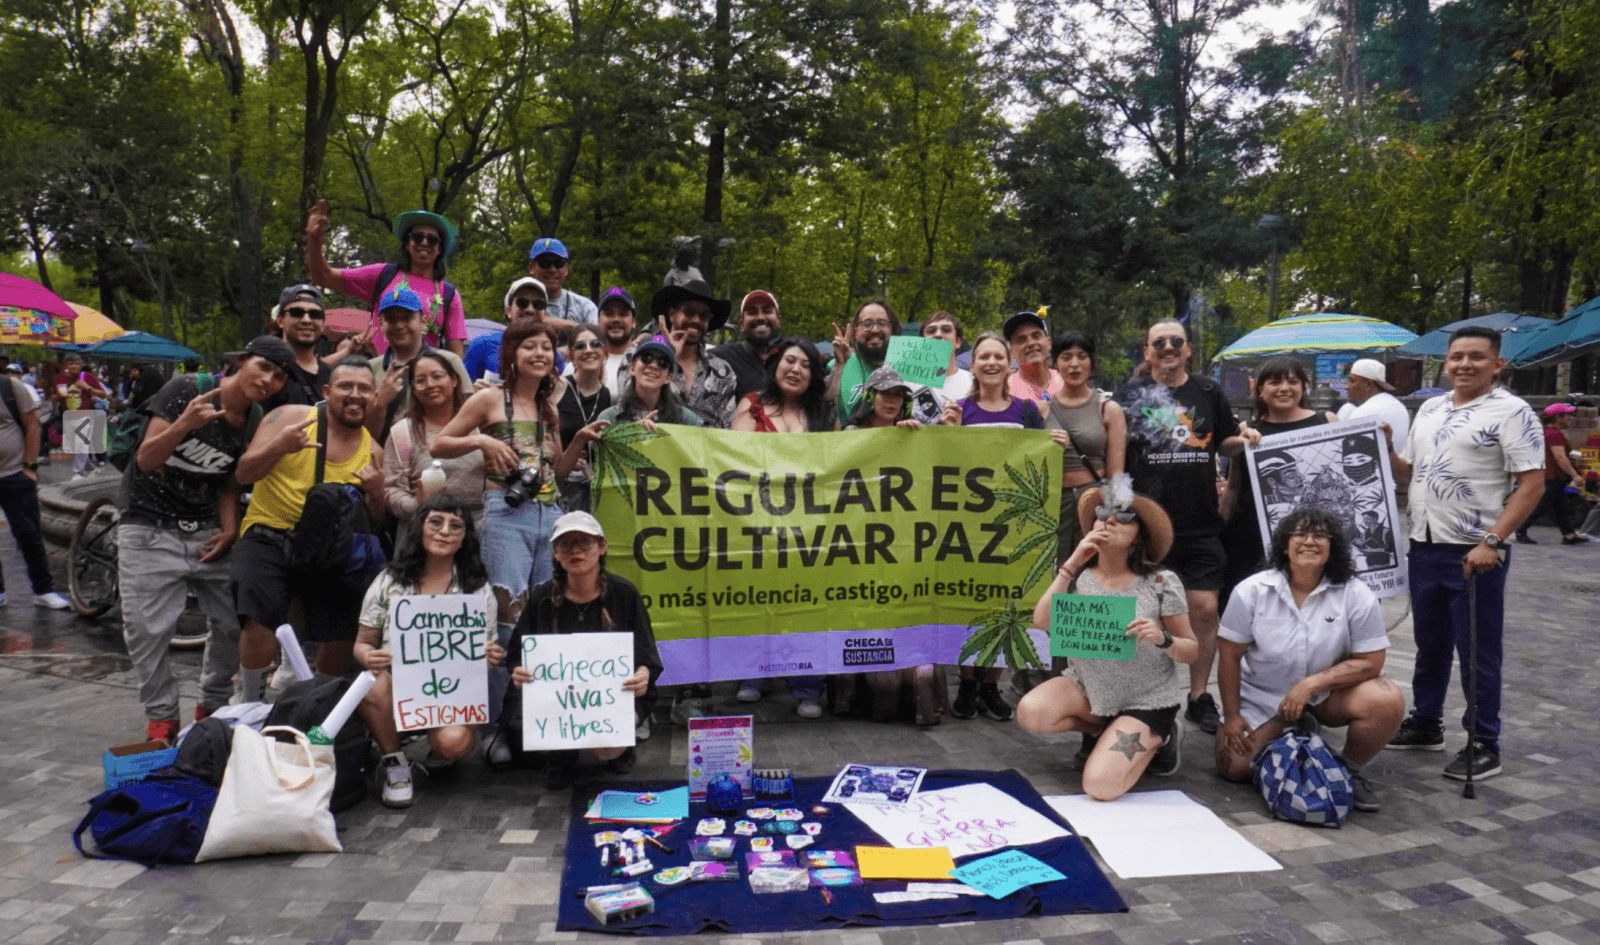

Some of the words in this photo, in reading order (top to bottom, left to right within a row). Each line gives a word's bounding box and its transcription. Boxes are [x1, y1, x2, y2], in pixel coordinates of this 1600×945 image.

[175, 438, 236, 471] NIKE
[635, 467, 917, 516] REGULAR
[931, 466, 996, 513] ES
[633, 523, 899, 572] CULTIVAR
[914, 521, 1009, 565] PAZ
[642, 594, 653, 610] o
[659, 586, 707, 608] más
[712, 583, 818, 606] violencia,
[825, 580, 908, 604] castigo,
[914, 577, 930, 597] ni
[934, 578, 1024, 602] estigma
[1056, 599, 1085, 614] NADA
[1089, 601, 1113, 615] MÁS
[395, 598, 487, 631] Cannabis
[1056, 613, 1122, 631] PATRIARCAL
[400, 629, 487, 665] LIBRE
[845, 638, 884, 647] CHECA
[1056, 627, 1078, 638] QUE
[1061, 639, 1080, 650] CON
[521, 637, 630, 683] Pachecas
[758, 663, 798, 672] INSTITUTO
[798, 662, 813, 670] RIA
[845, 650, 893, 663] SUSTANCIA
[421, 668, 460, 699] de
[556, 684, 615, 711] vivas
[397, 698, 487, 730] ESTIGMAS
[906, 818, 1017, 847] GUERRA
[965, 833, 1009, 852] NO
